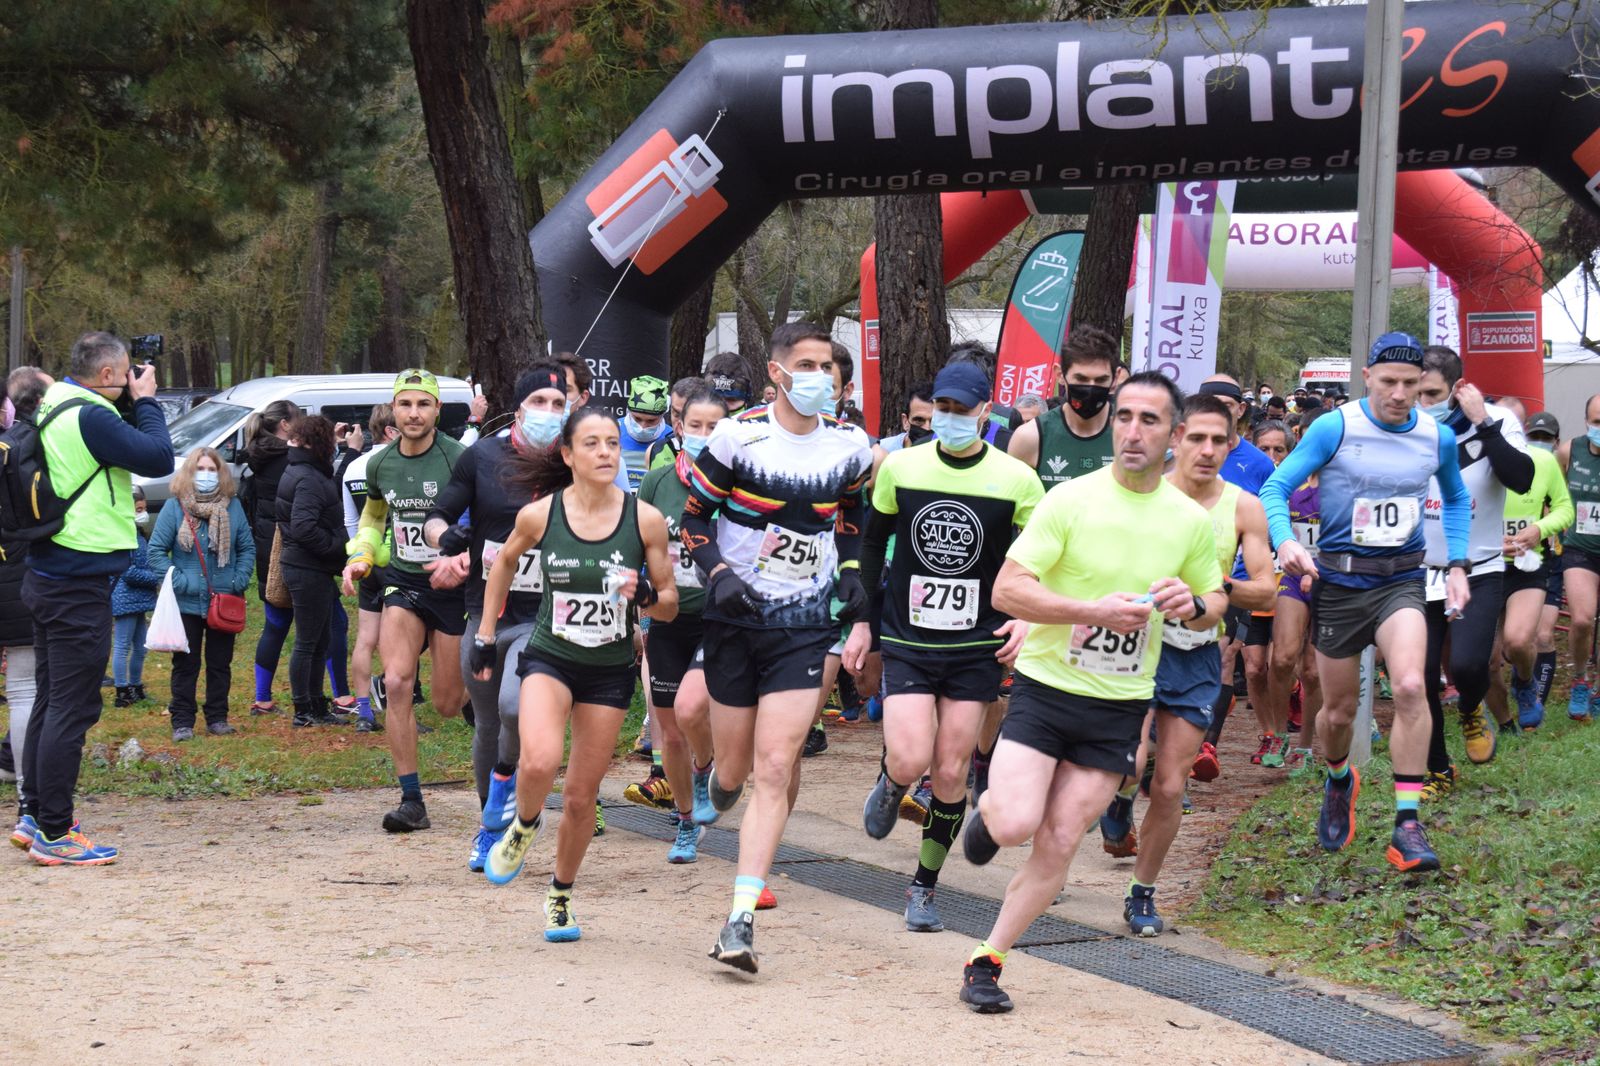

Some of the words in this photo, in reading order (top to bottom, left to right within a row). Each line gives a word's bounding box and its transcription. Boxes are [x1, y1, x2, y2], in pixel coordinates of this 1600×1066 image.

[794, 170, 948, 192] Cirugía
[962, 164, 1043, 185] oral
[1059, 167, 1081, 180] e
[1096, 156, 1312, 179] implantes
[1325, 143, 1518, 168] dtales
[1187, 296, 1208, 360] kutxa
[1482, 334, 1534, 346] ZAMORA
[1374, 502, 1399, 527] 10
[920, 523, 974, 545] SAUCO
[770, 534, 819, 566] 254
[921, 582, 967, 611] 279
[566, 598, 614, 626] 225
[1082, 625, 1140, 655] 258
